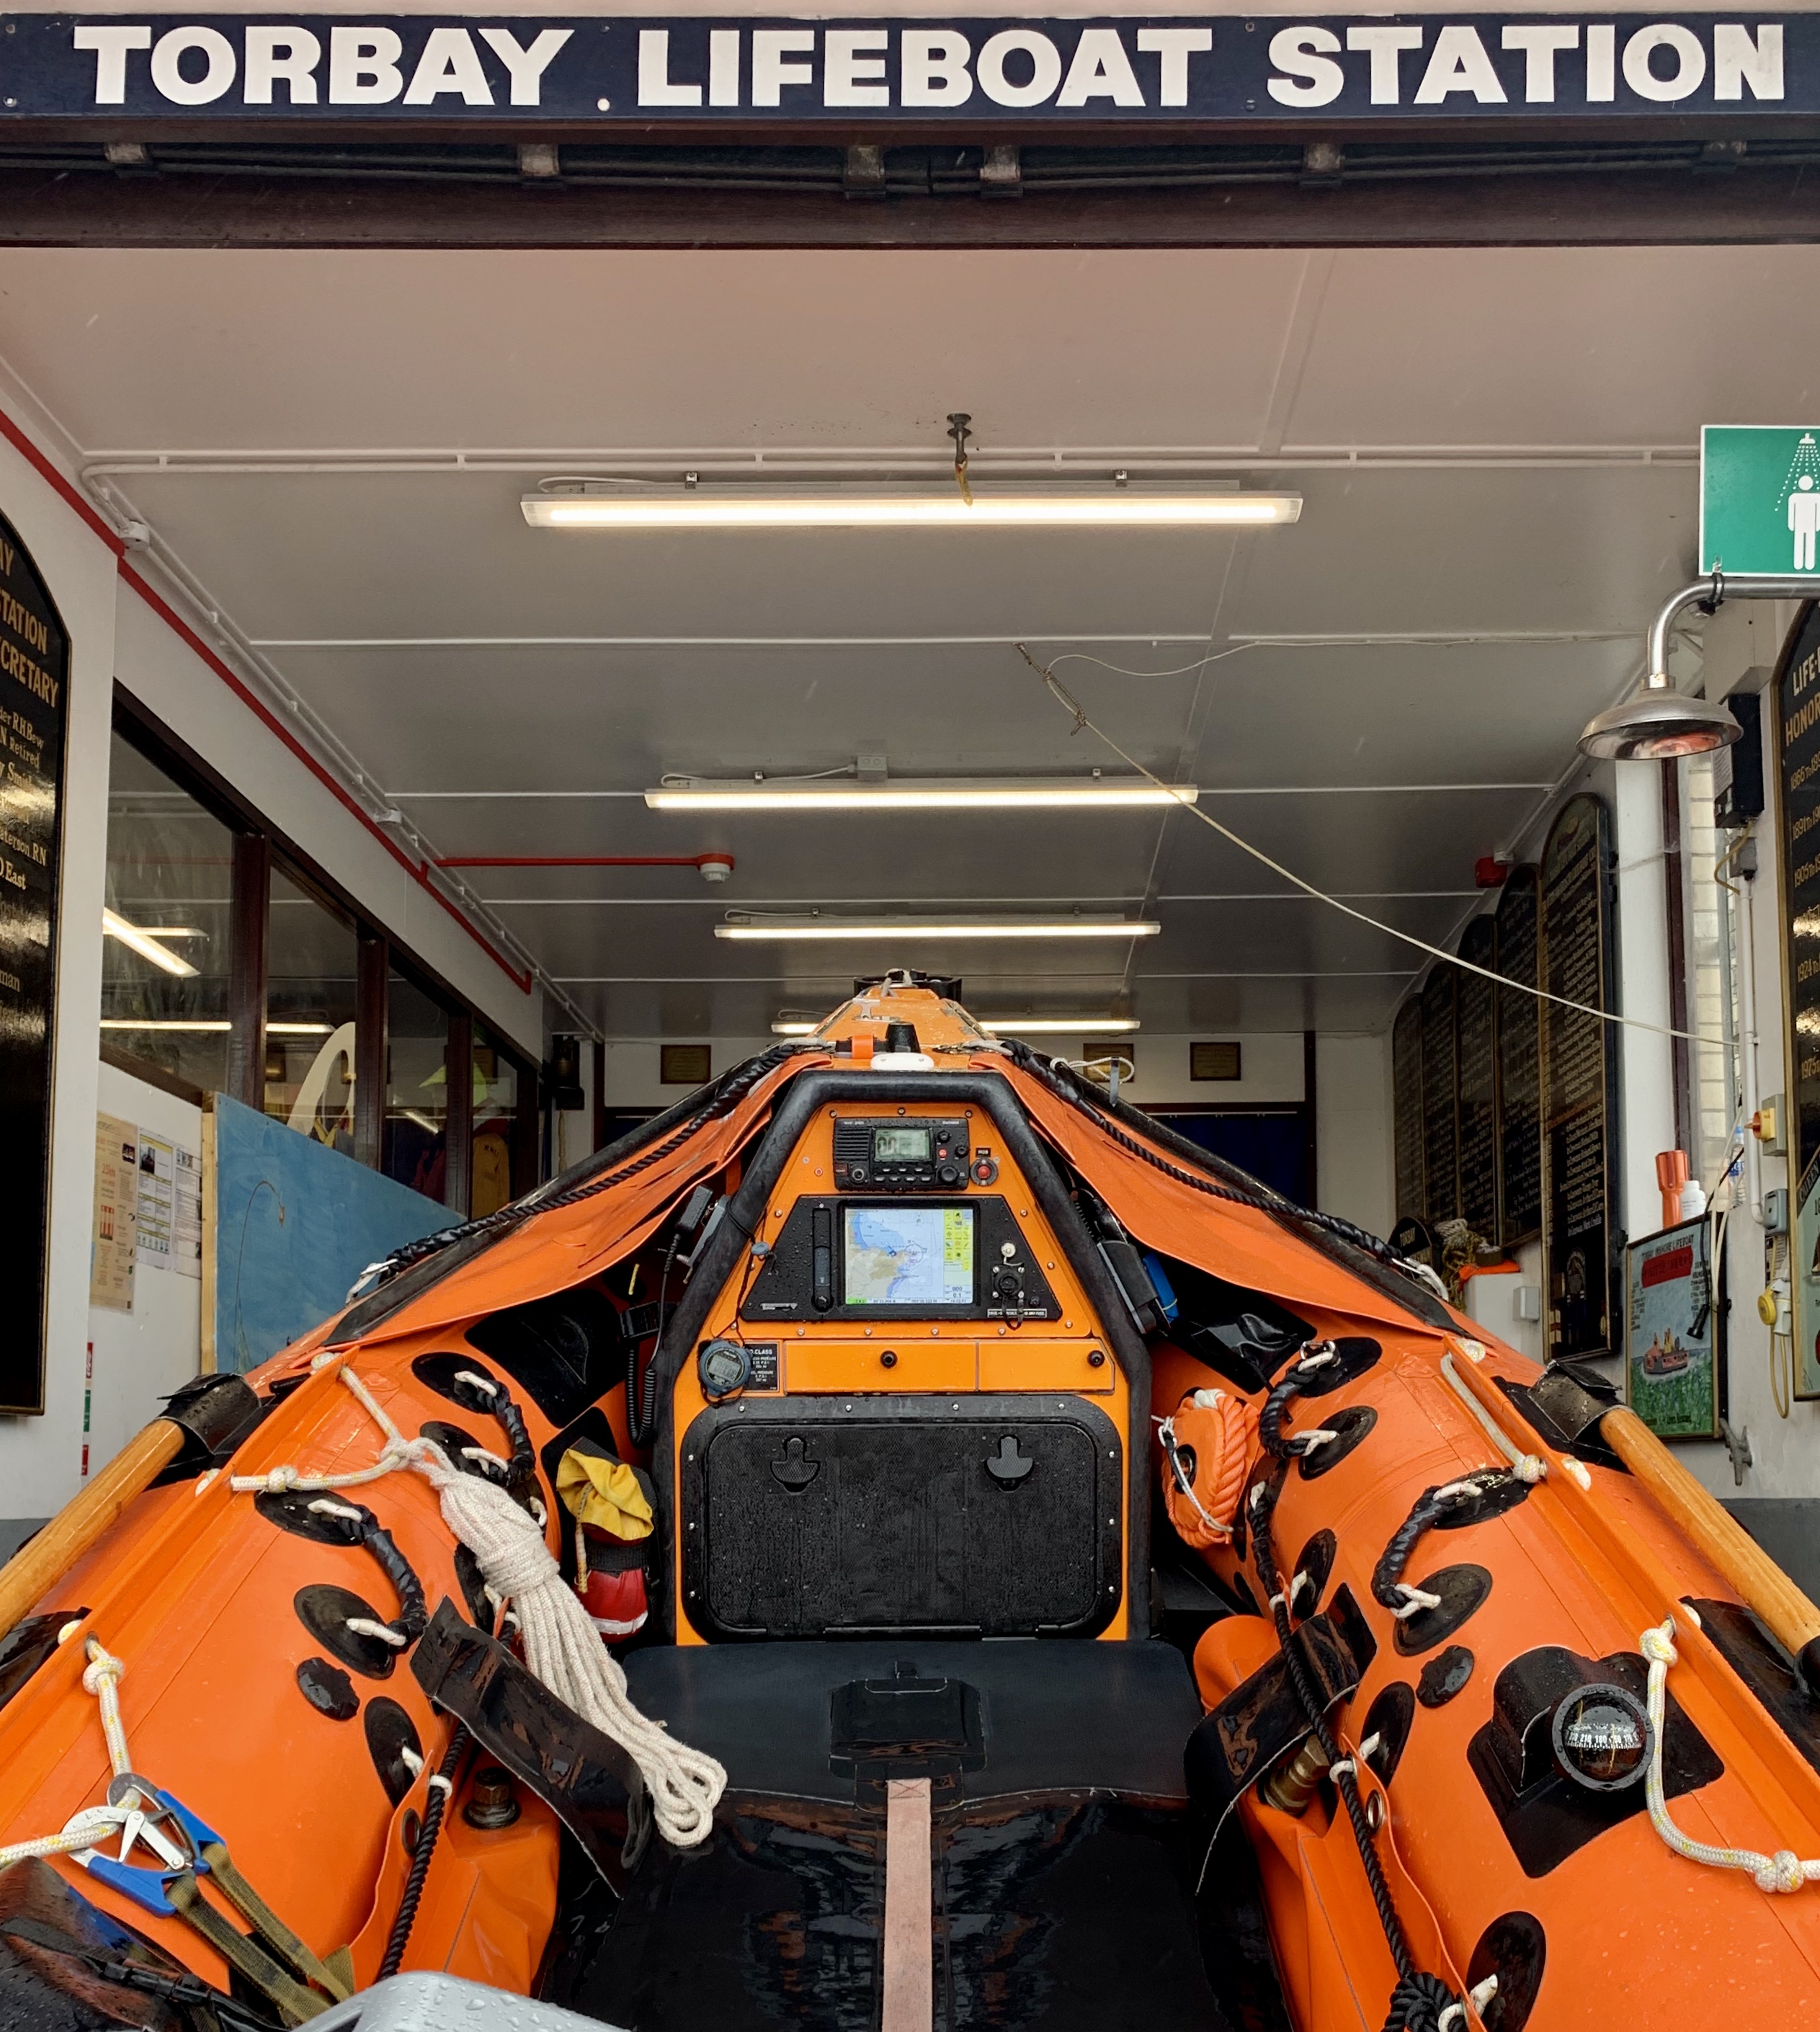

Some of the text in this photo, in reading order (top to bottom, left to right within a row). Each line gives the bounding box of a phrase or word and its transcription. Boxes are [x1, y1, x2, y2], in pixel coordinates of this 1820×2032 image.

[73, 23, 1785, 107] TORBAY LIFEBOAT STATION
[0, 587, 48, 656] TATION
[0, 637, 58, 708] CRETARY
[9, 736, 40, 770] Retired
[32, 842, 47, 866] RN
